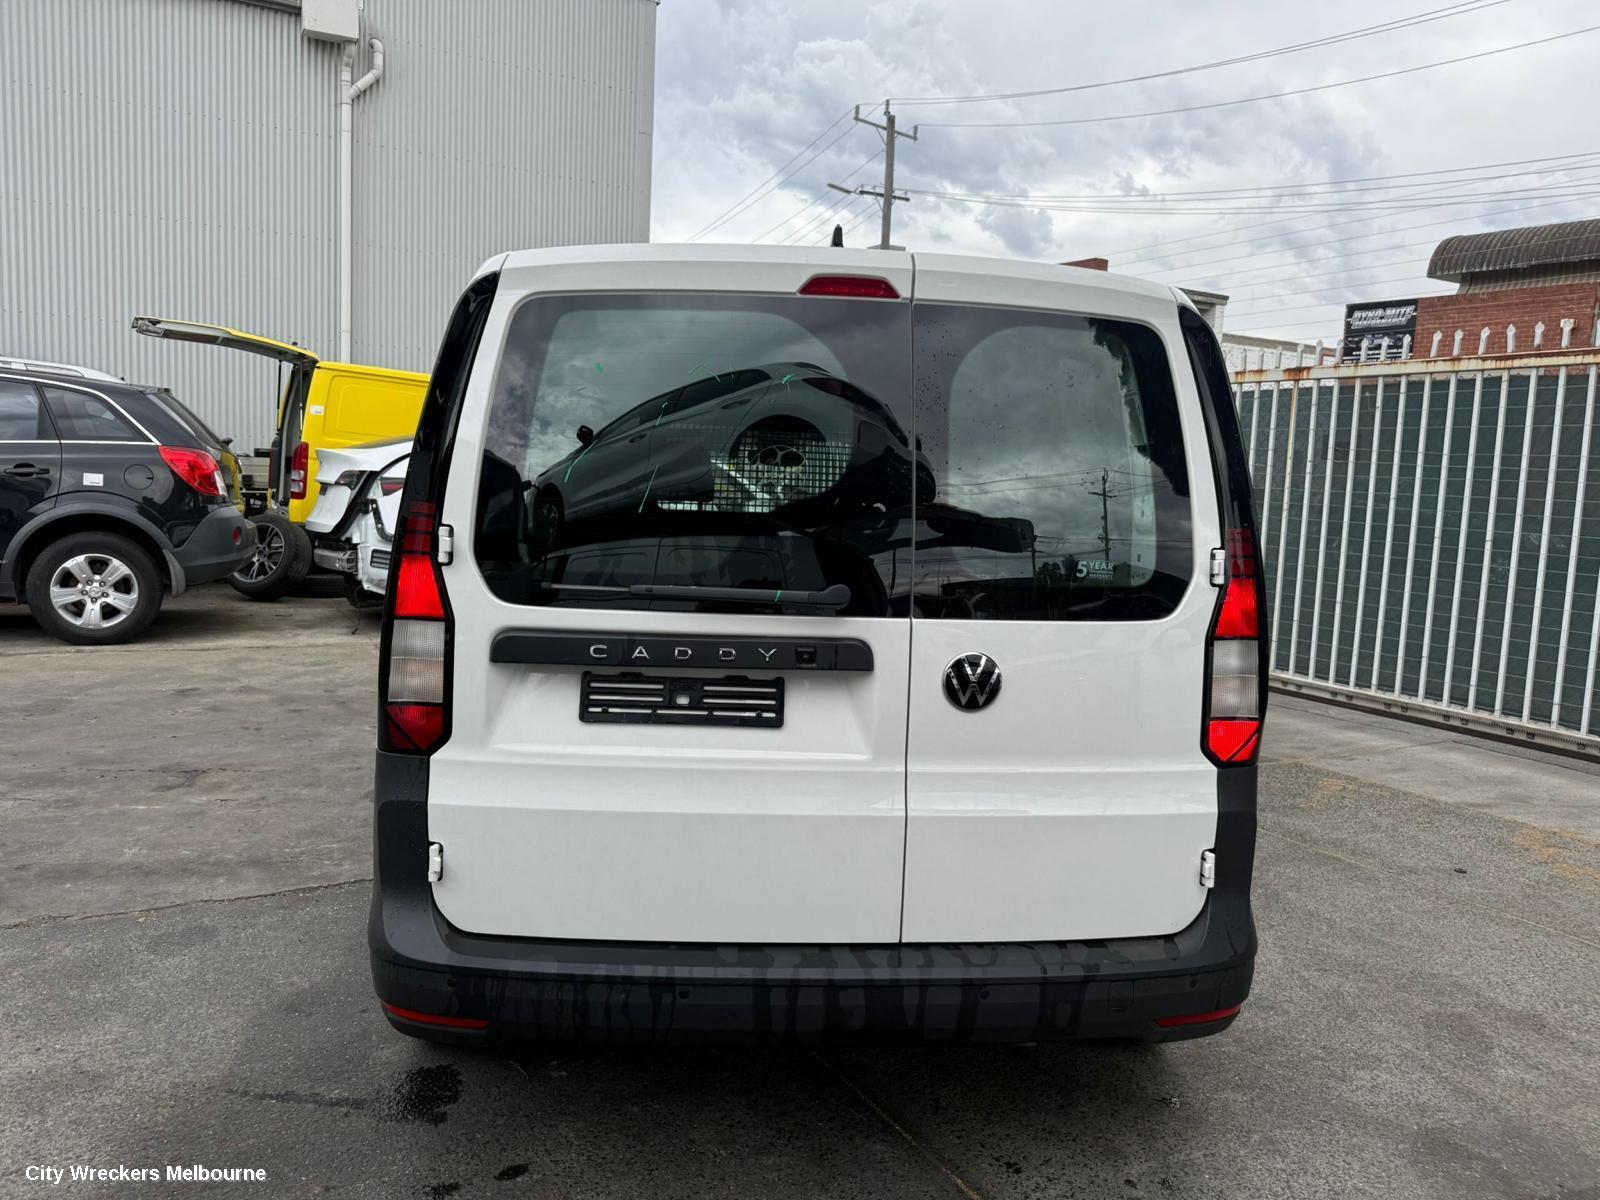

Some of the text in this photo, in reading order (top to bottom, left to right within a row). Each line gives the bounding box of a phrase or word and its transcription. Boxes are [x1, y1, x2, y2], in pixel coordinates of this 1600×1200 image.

[1076, 560, 1113, 577] 5 YEAR
[589, 644, 777, 661] CADDY
